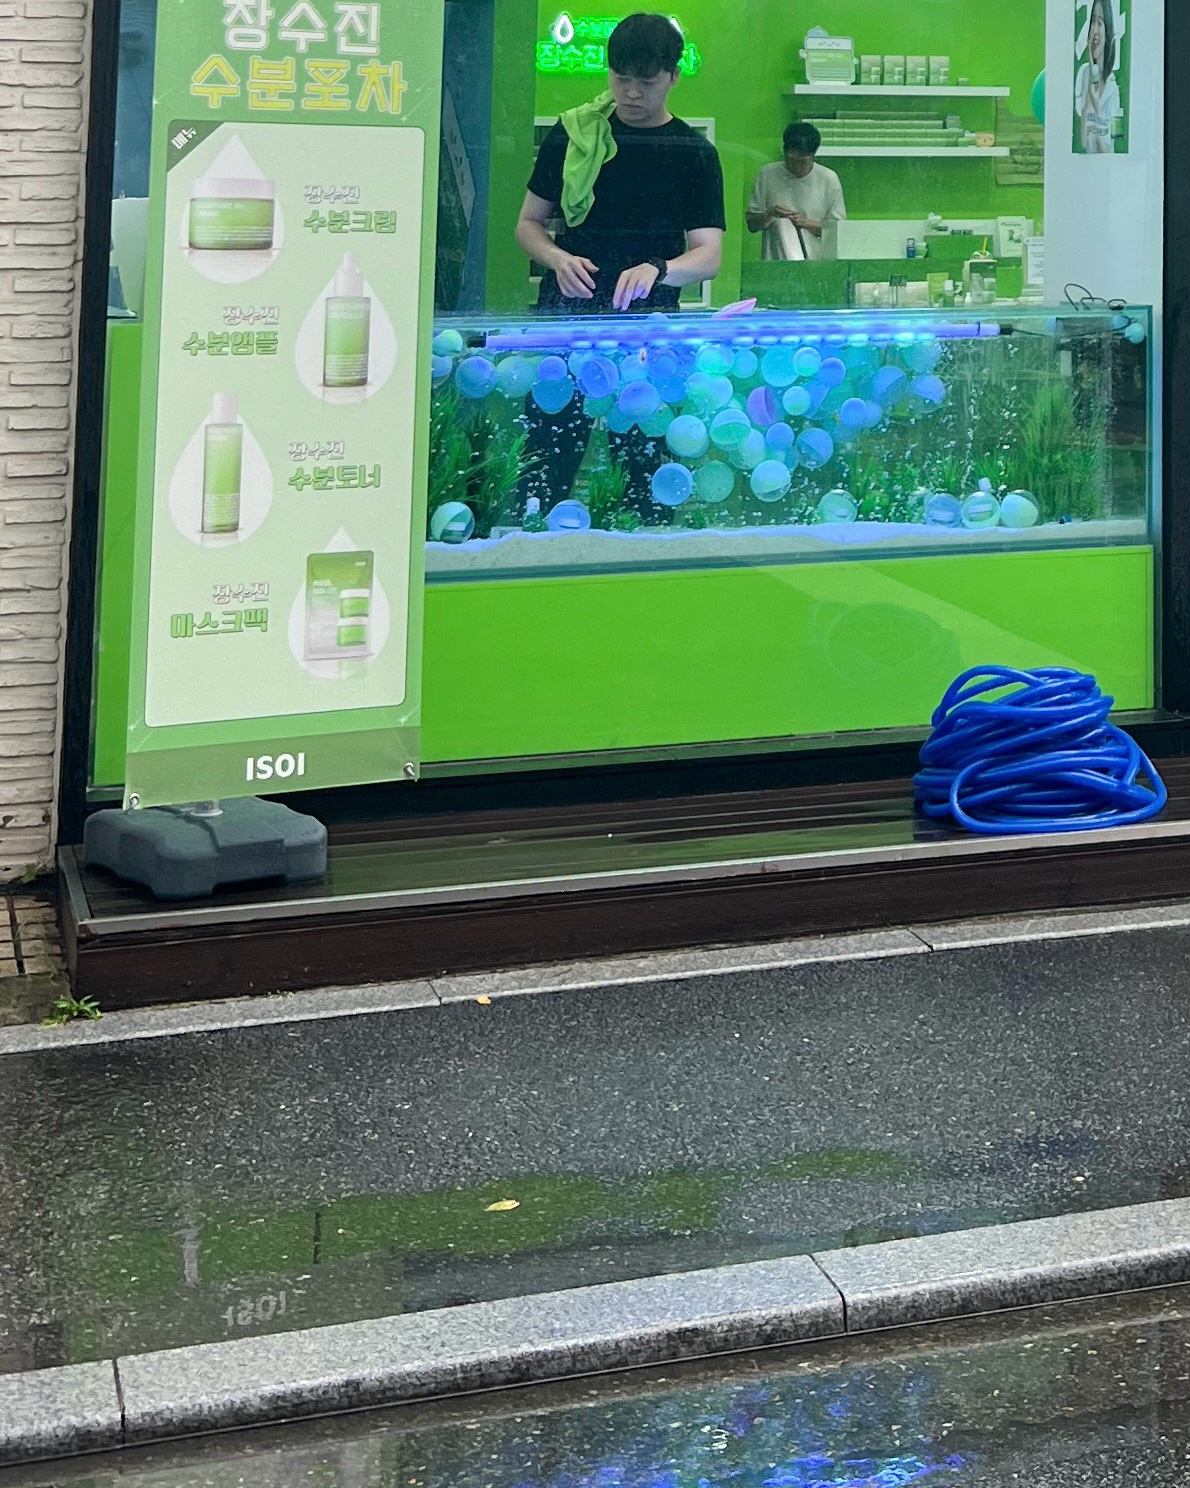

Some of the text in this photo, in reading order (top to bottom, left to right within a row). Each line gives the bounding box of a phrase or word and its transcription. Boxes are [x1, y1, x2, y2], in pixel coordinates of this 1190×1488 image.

[539, 45, 604, 69] 장수진
[190, 54, 408, 115] 수분포차
[171, 127, 197, 150] 메뉴
[304, 185, 360, 204] 장수진
[303, 210, 397, 233] 수분크림
[222, 306, 280, 326] 장수진
[182, 330, 279, 356] 수분앰플
[288, 441, 346, 461] 장수진
[288, 463, 381, 492] 수분토너
[212, 581, 270, 604] 장수진
[170, 606, 269, 639] 마스크팩
[245, 752, 306, 782] ISOI
